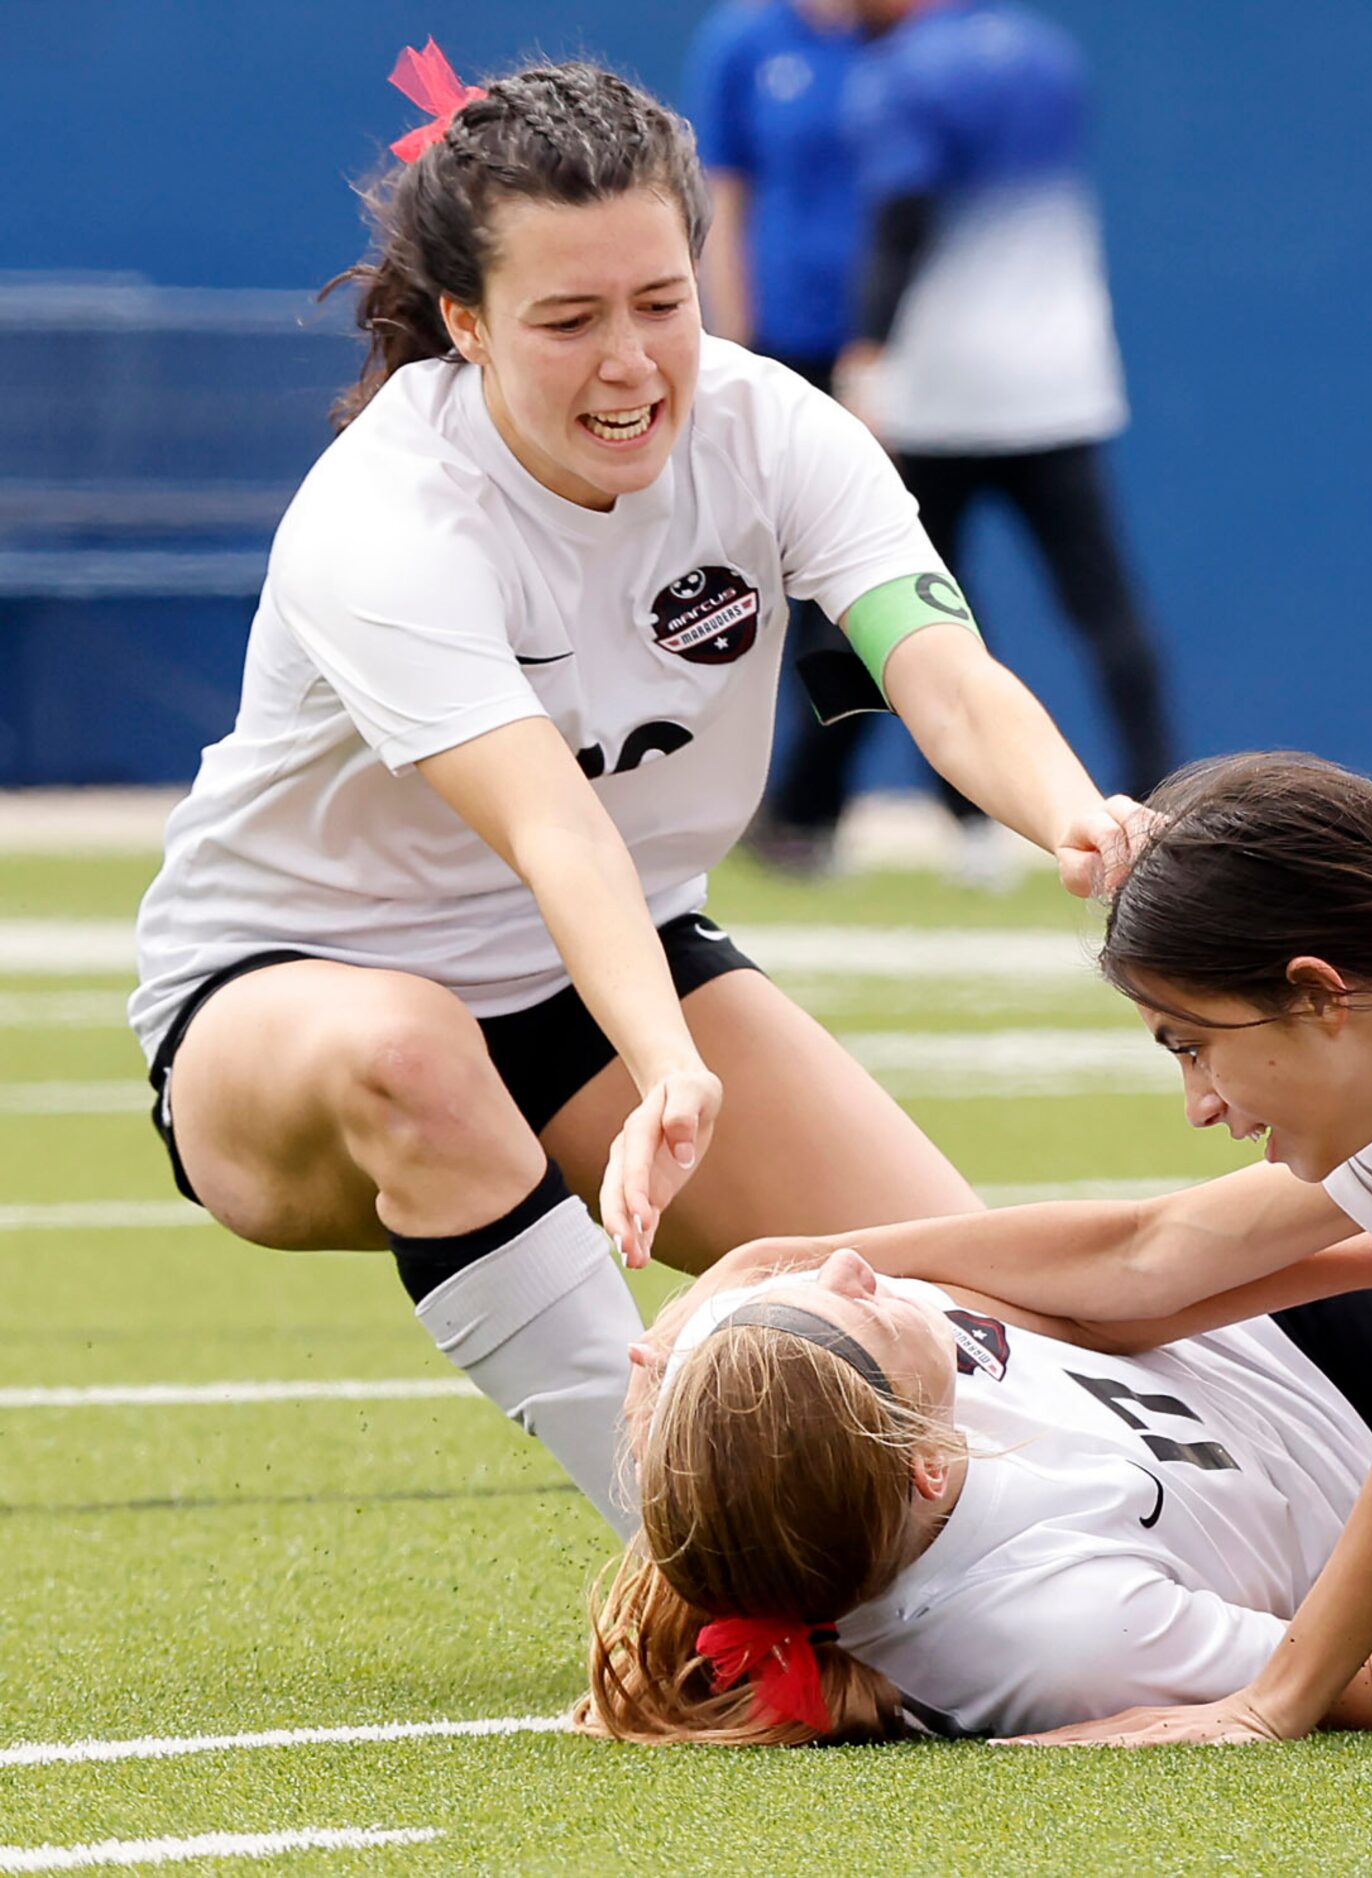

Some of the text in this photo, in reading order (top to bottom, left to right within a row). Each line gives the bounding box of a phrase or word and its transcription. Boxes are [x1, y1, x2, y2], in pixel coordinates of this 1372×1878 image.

[915, 573, 969, 620] C
[680, 604, 743, 645] MARAUDERS
[1061, 1367, 1242, 1473] 17
